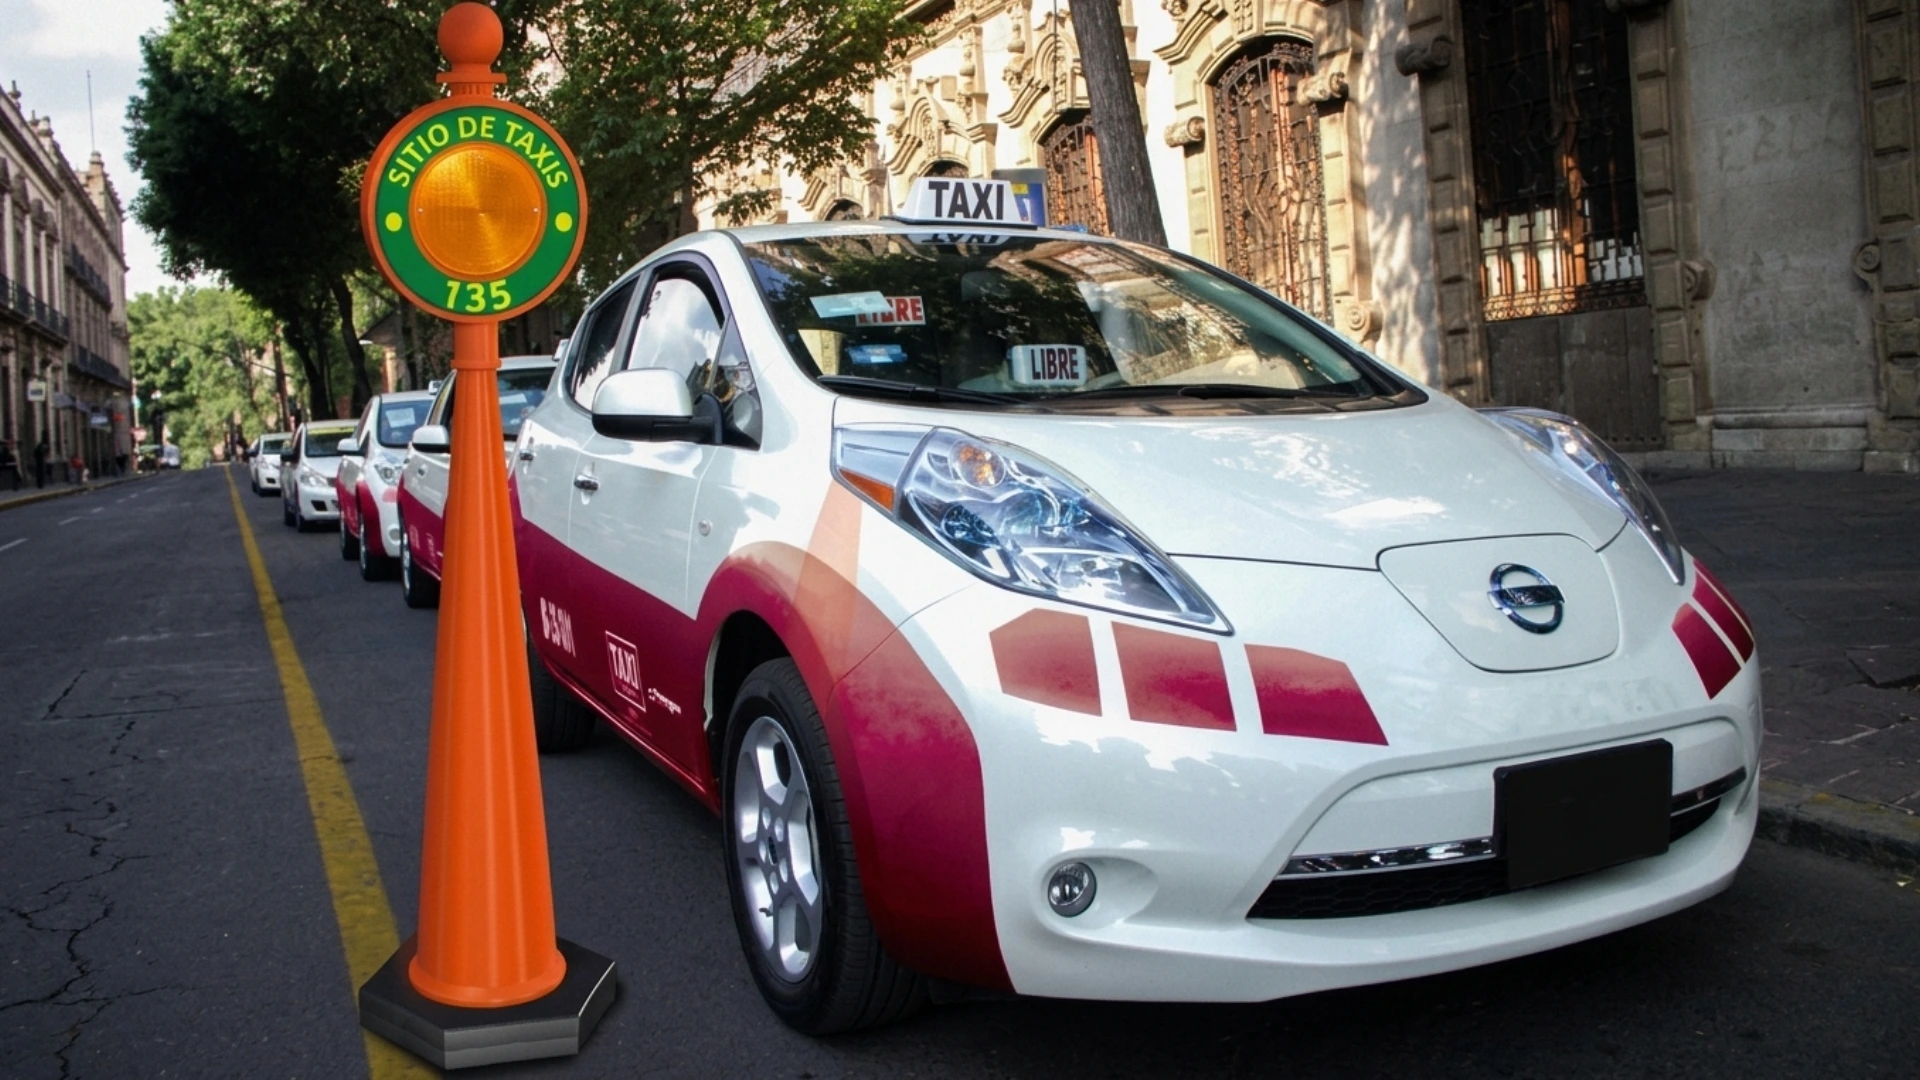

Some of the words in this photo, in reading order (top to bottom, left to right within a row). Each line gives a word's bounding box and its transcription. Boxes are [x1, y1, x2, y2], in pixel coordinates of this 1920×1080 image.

[388, 124, 449, 188] SITIO
[458, 116, 496, 138] DE
[505, 120, 568, 188] TAXIS
[928, 181, 1004, 221] TAXI
[1030, 348, 1080, 380] LIBRE
